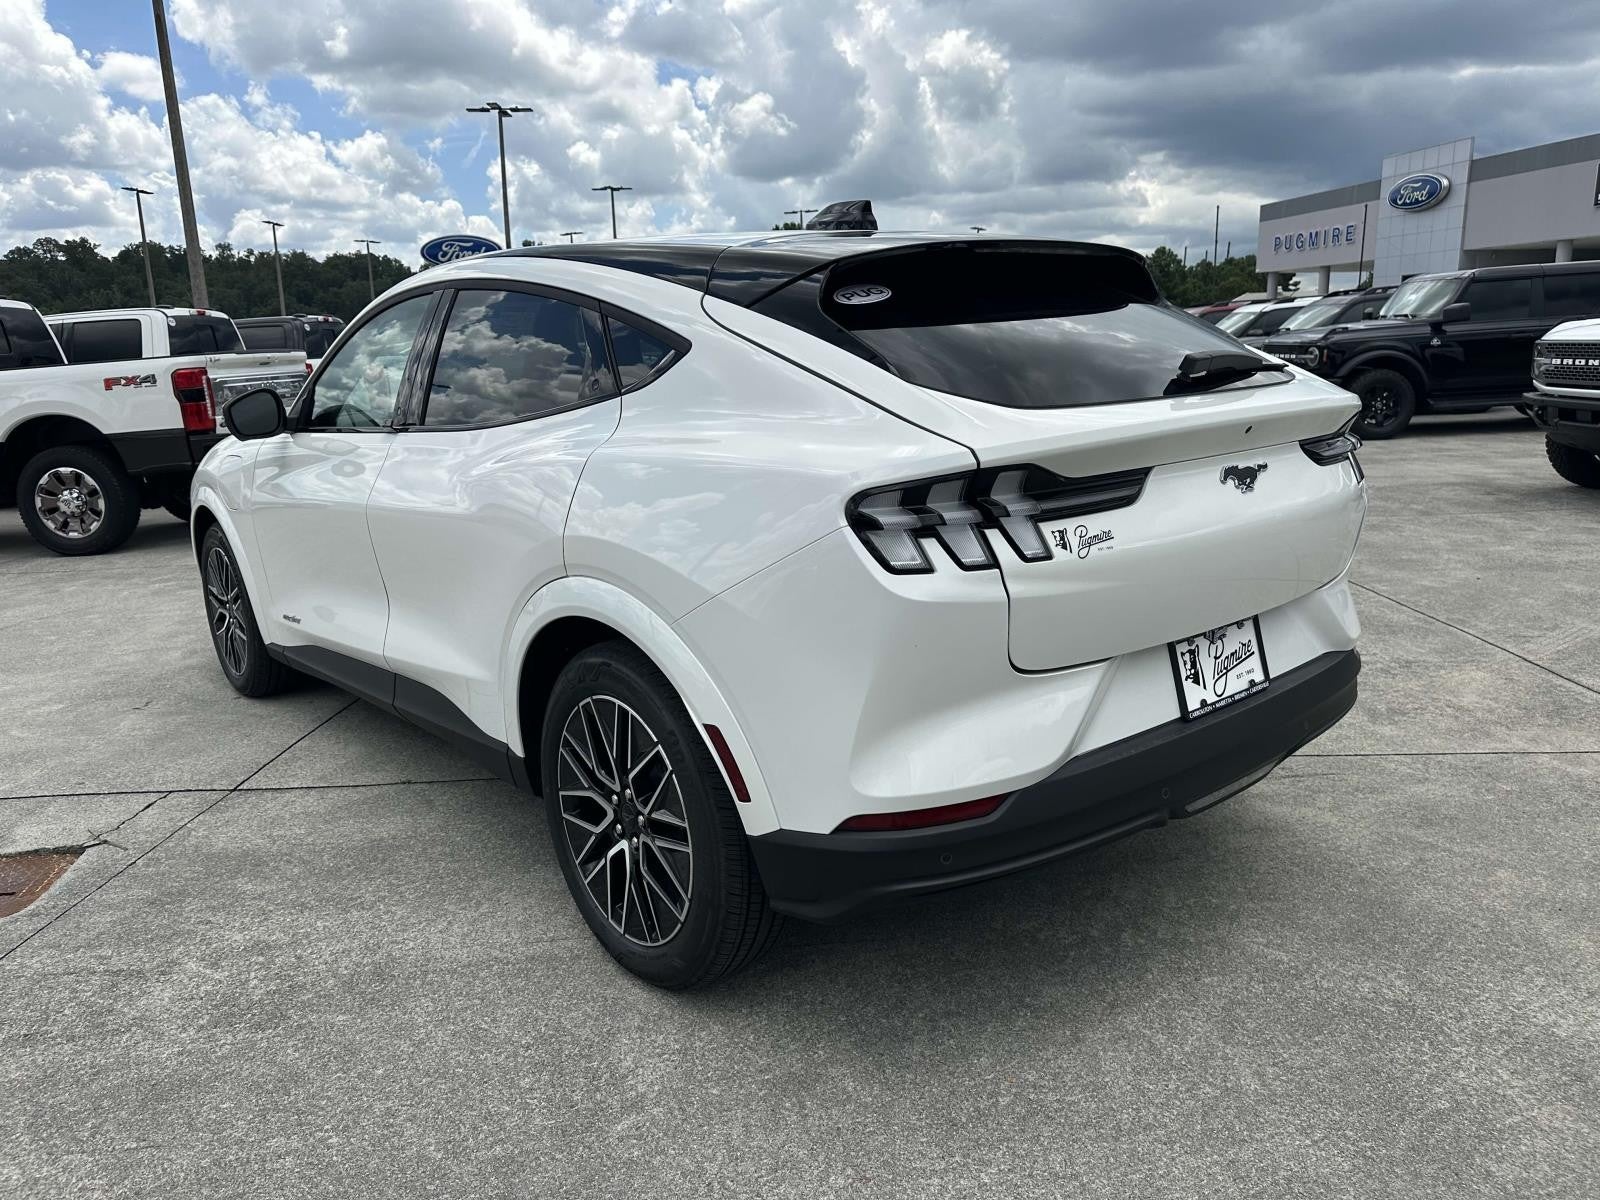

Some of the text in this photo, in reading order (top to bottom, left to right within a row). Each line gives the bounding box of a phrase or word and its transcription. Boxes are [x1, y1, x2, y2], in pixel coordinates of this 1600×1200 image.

[1397, 182, 1428, 204] Ford
[1274, 224, 1356, 252] PUGMIRE
[841, 287, 886, 301] PUG
[1552, 358, 1600, 366] BRON
[103, 373, 157, 391] FX4
[1074, 524, 1115, 559] Pugmire
[1208, 638, 1255, 698] Pugmire
